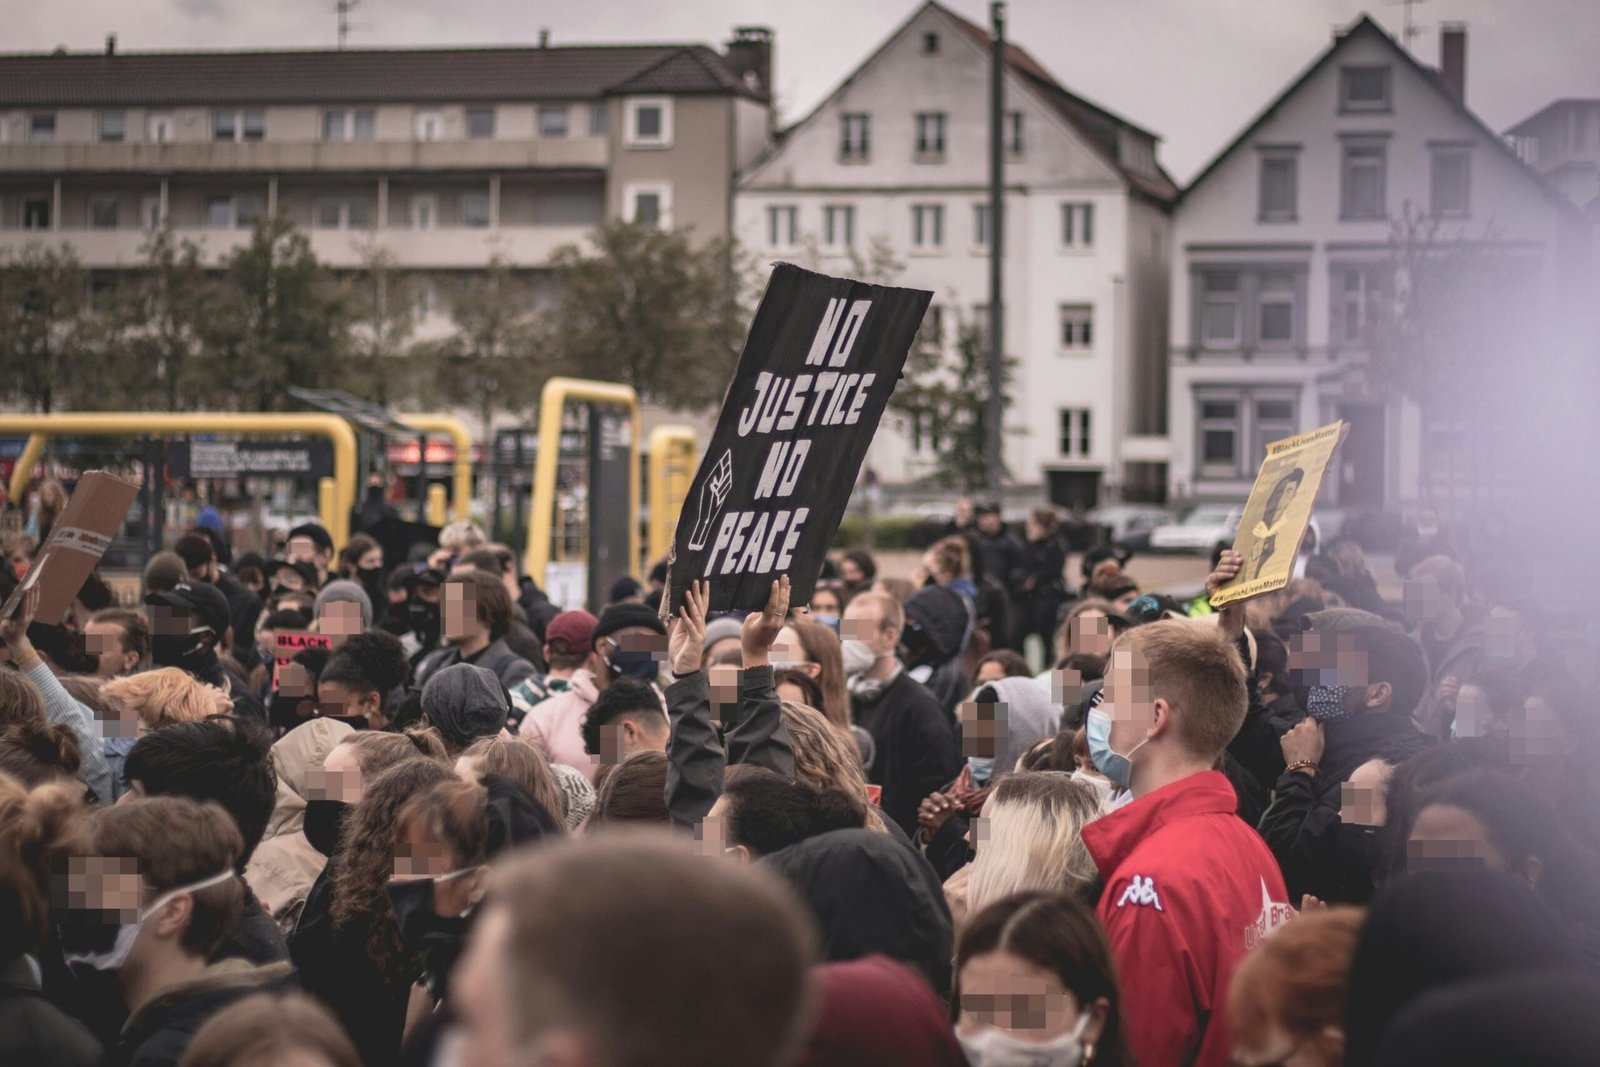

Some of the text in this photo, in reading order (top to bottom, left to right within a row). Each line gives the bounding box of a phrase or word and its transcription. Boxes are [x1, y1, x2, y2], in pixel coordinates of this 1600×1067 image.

[805, 297, 872, 367] NO
[737, 371, 876, 437] JUSTICE
[1272, 427, 1338, 454] #BlackLivesMatter
[754, 439, 812, 500] NO
[703, 507, 810, 577] PEACE
[1214, 577, 1287, 601] #KurdishLivesMatter
[277, 635, 328, 650] BLACK
[1270, 904, 1292, 928] Bra
